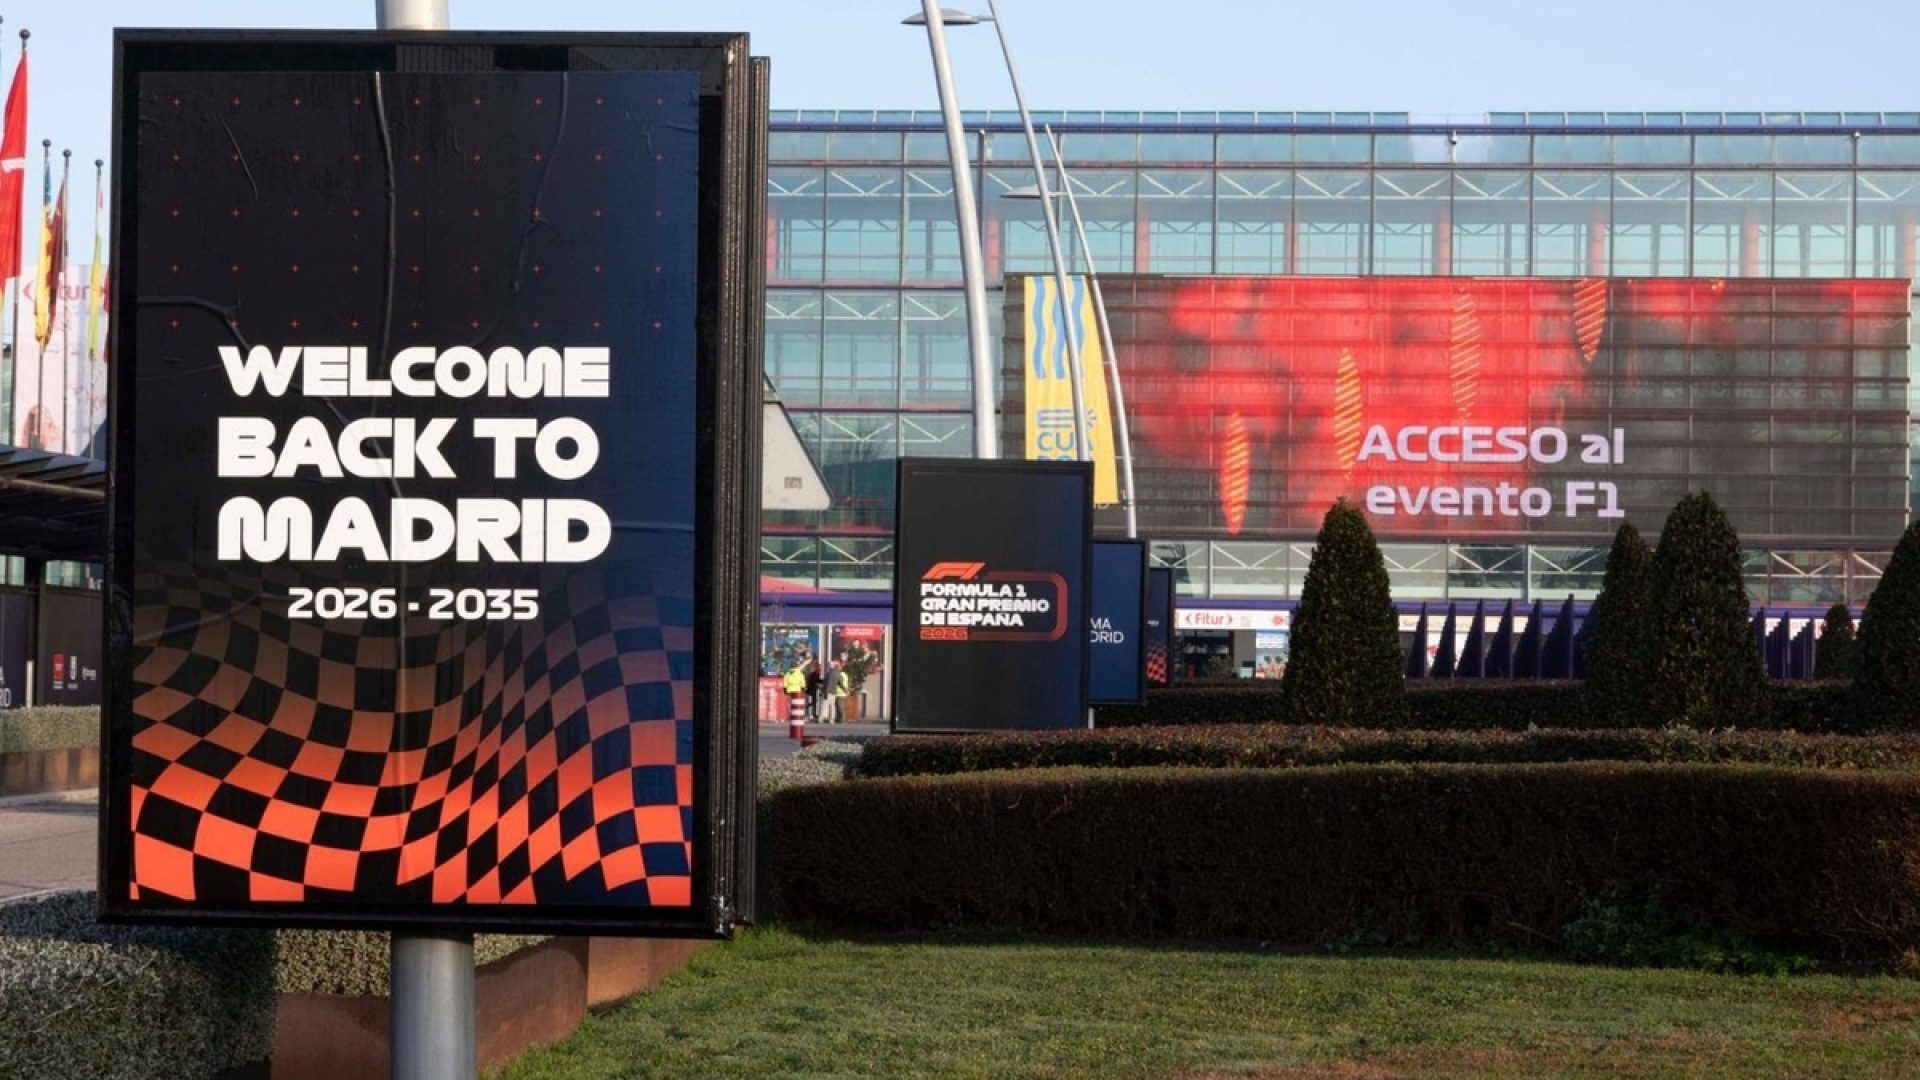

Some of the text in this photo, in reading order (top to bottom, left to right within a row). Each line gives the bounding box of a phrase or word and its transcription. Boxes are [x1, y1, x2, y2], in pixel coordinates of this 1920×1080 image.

[218, 345, 610, 398] WELCOME
[218, 416, 600, 480] BACK TO
[1357, 424, 1625, 464] ACCESO al
[1366, 481, 1625, 518] evento F1
[218, 496, 612, 563] MADRID
[288, 587, 398, 619] 2026
[429, 588, 539, 620] 2035
[920, 583, 1027, 597] FORMULA 1
[920, 598, 1050, 612] GRAN PREMIO
[920, 612, 945, 625] DE
[1195, 612, 1225, 625] Fitur
